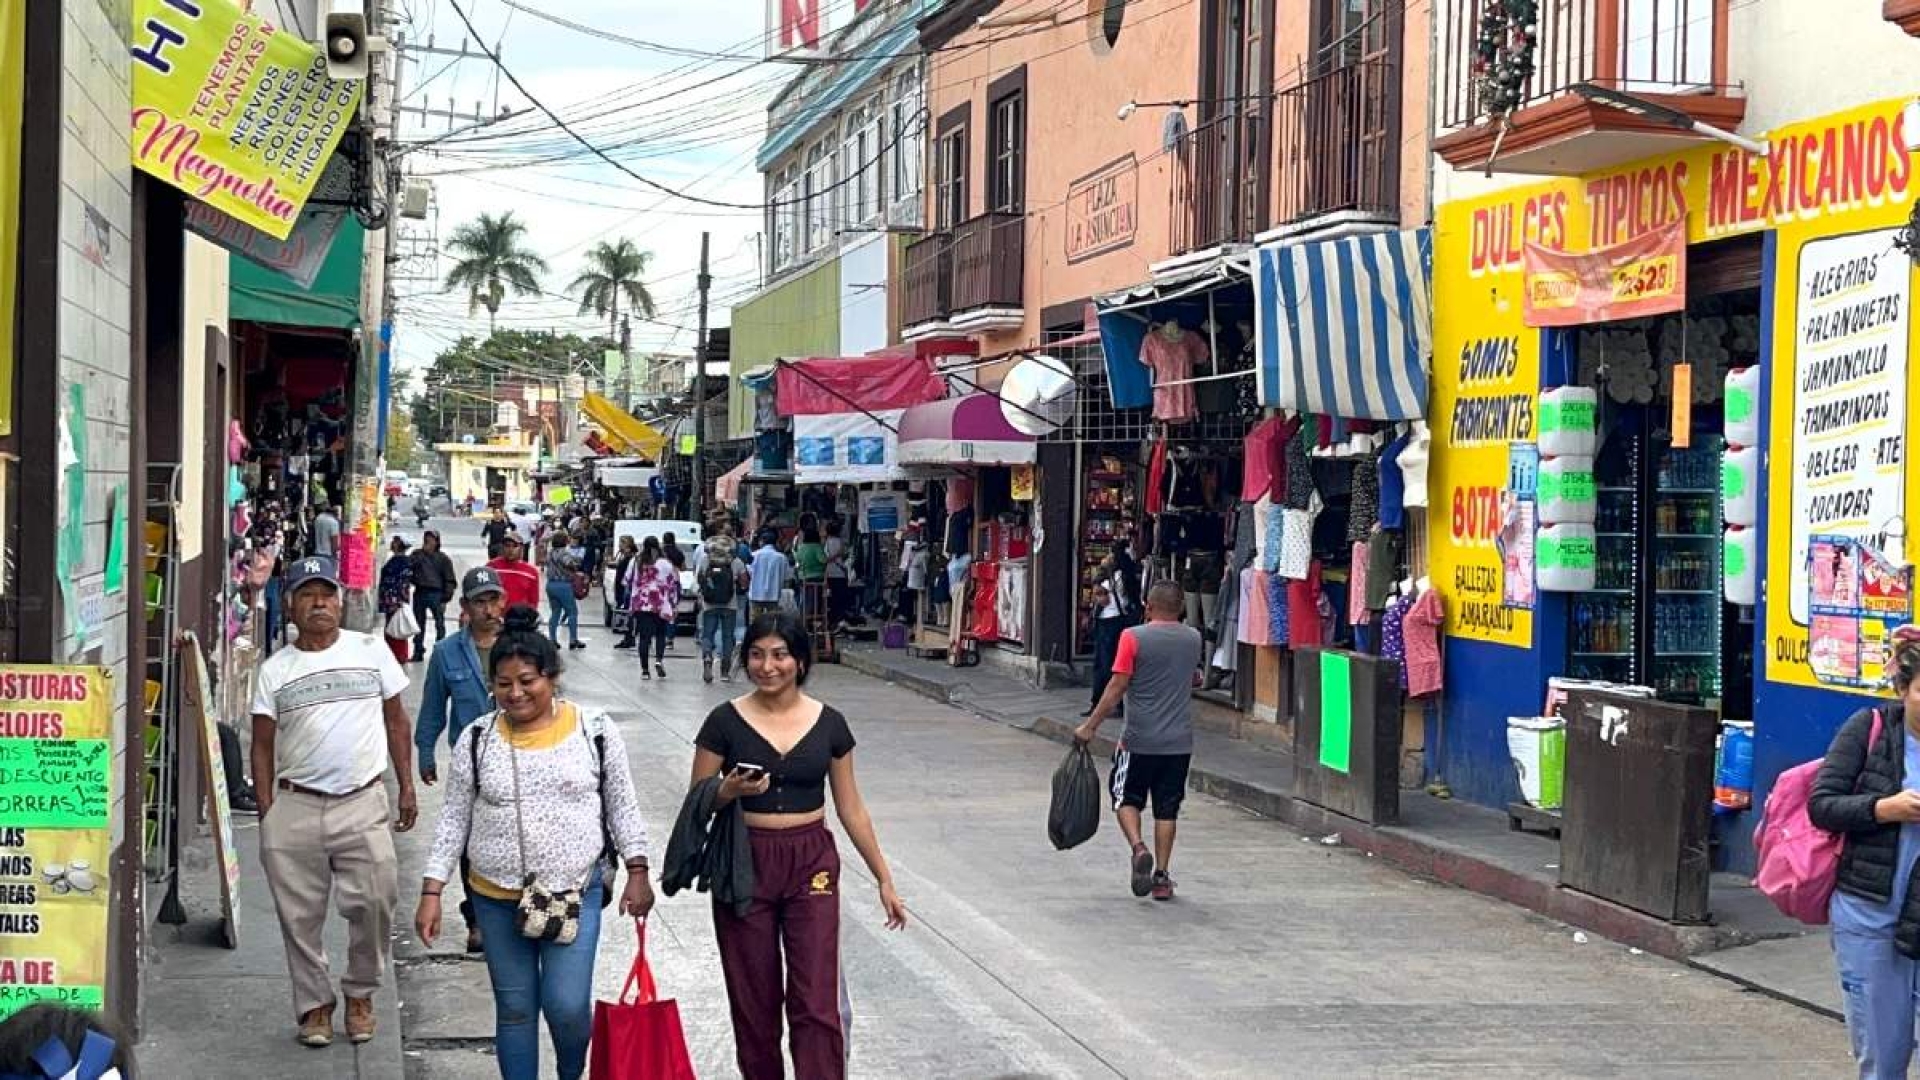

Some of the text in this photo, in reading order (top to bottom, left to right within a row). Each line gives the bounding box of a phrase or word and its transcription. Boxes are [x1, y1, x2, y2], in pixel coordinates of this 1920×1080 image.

[189, 22, 250, 118] TENEMOS
[208, 38, 266, 130] PLANTAS
[337, 78, 359, 106] GR
[264, 52, 328, 162] COLESTERO
[279, 77, 338, 169] TRIGLICER
[131, 108, 295, 220] Magnolia
[1085, 175, 1118, 216] PLAZA
[1471, 110, 1911, 272] DULCES TIPICOS MEXICANOS
[1070, 222, 1083, 253] LA
[1460, 335, 1519, 384] SOMOS
[1449, 394, 1534, 445] FABRICANTES
[1455, 564, 1497, 597] GALLETAS
[1776, 634, 1808, 664] DULC
[0, 767, 105, 785] DESCUENTO
[24, 961, 54, 985] DE
